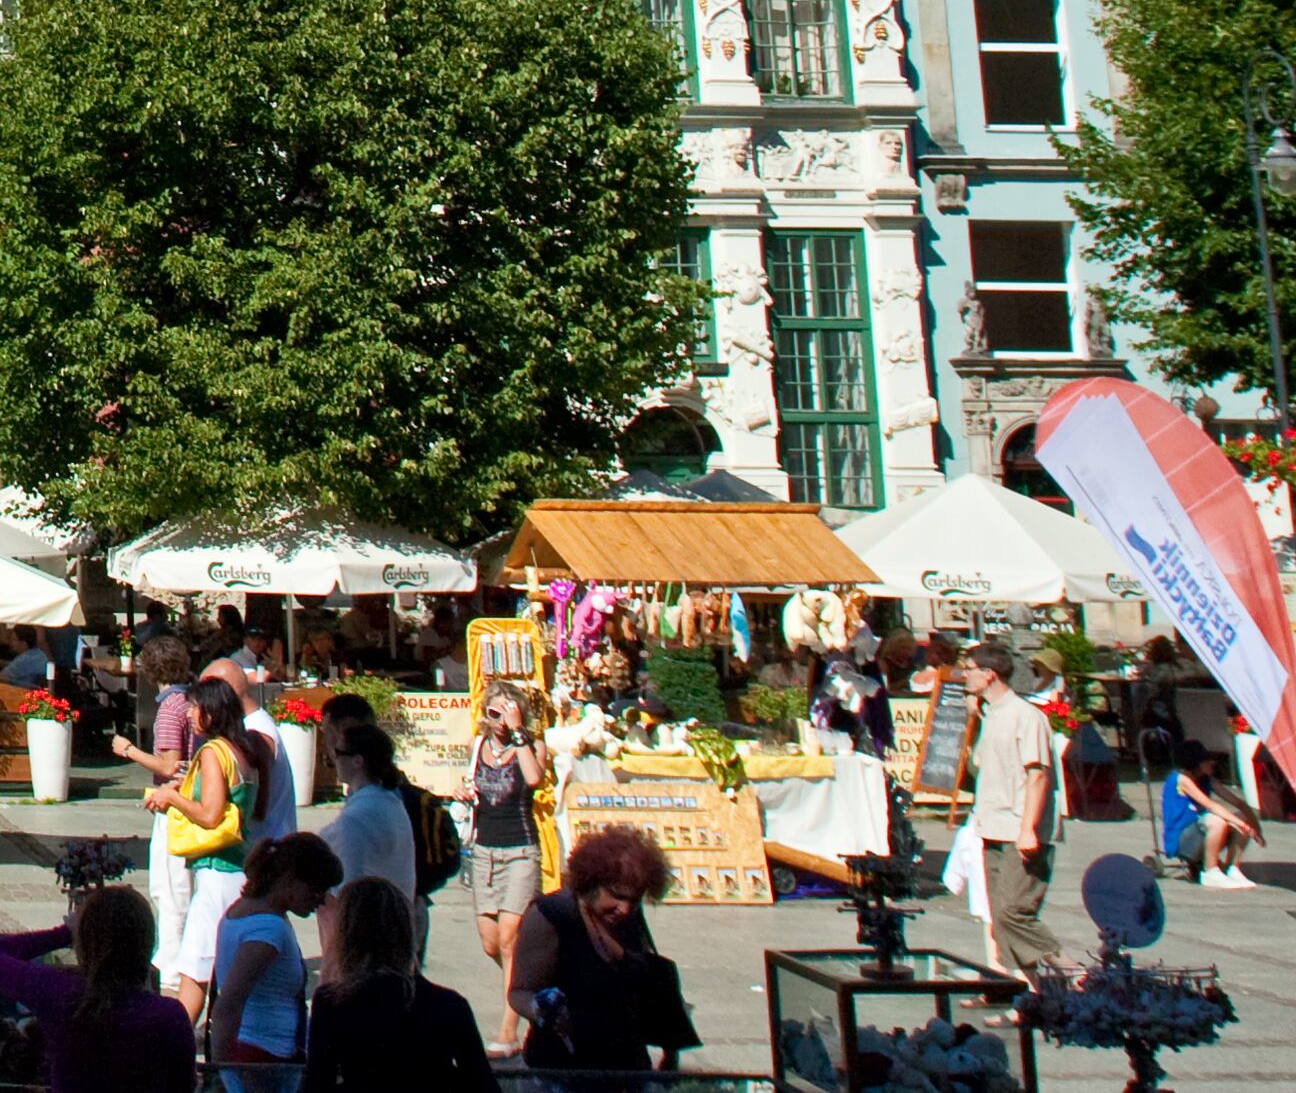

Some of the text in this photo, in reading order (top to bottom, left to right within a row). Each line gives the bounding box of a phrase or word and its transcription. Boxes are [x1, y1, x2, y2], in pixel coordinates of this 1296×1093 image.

[207, 561, 271, 587] Carlsberg
[382, 563, 430, 588] Carlsberg
[921, 570, 991, 595] Carlsberg
